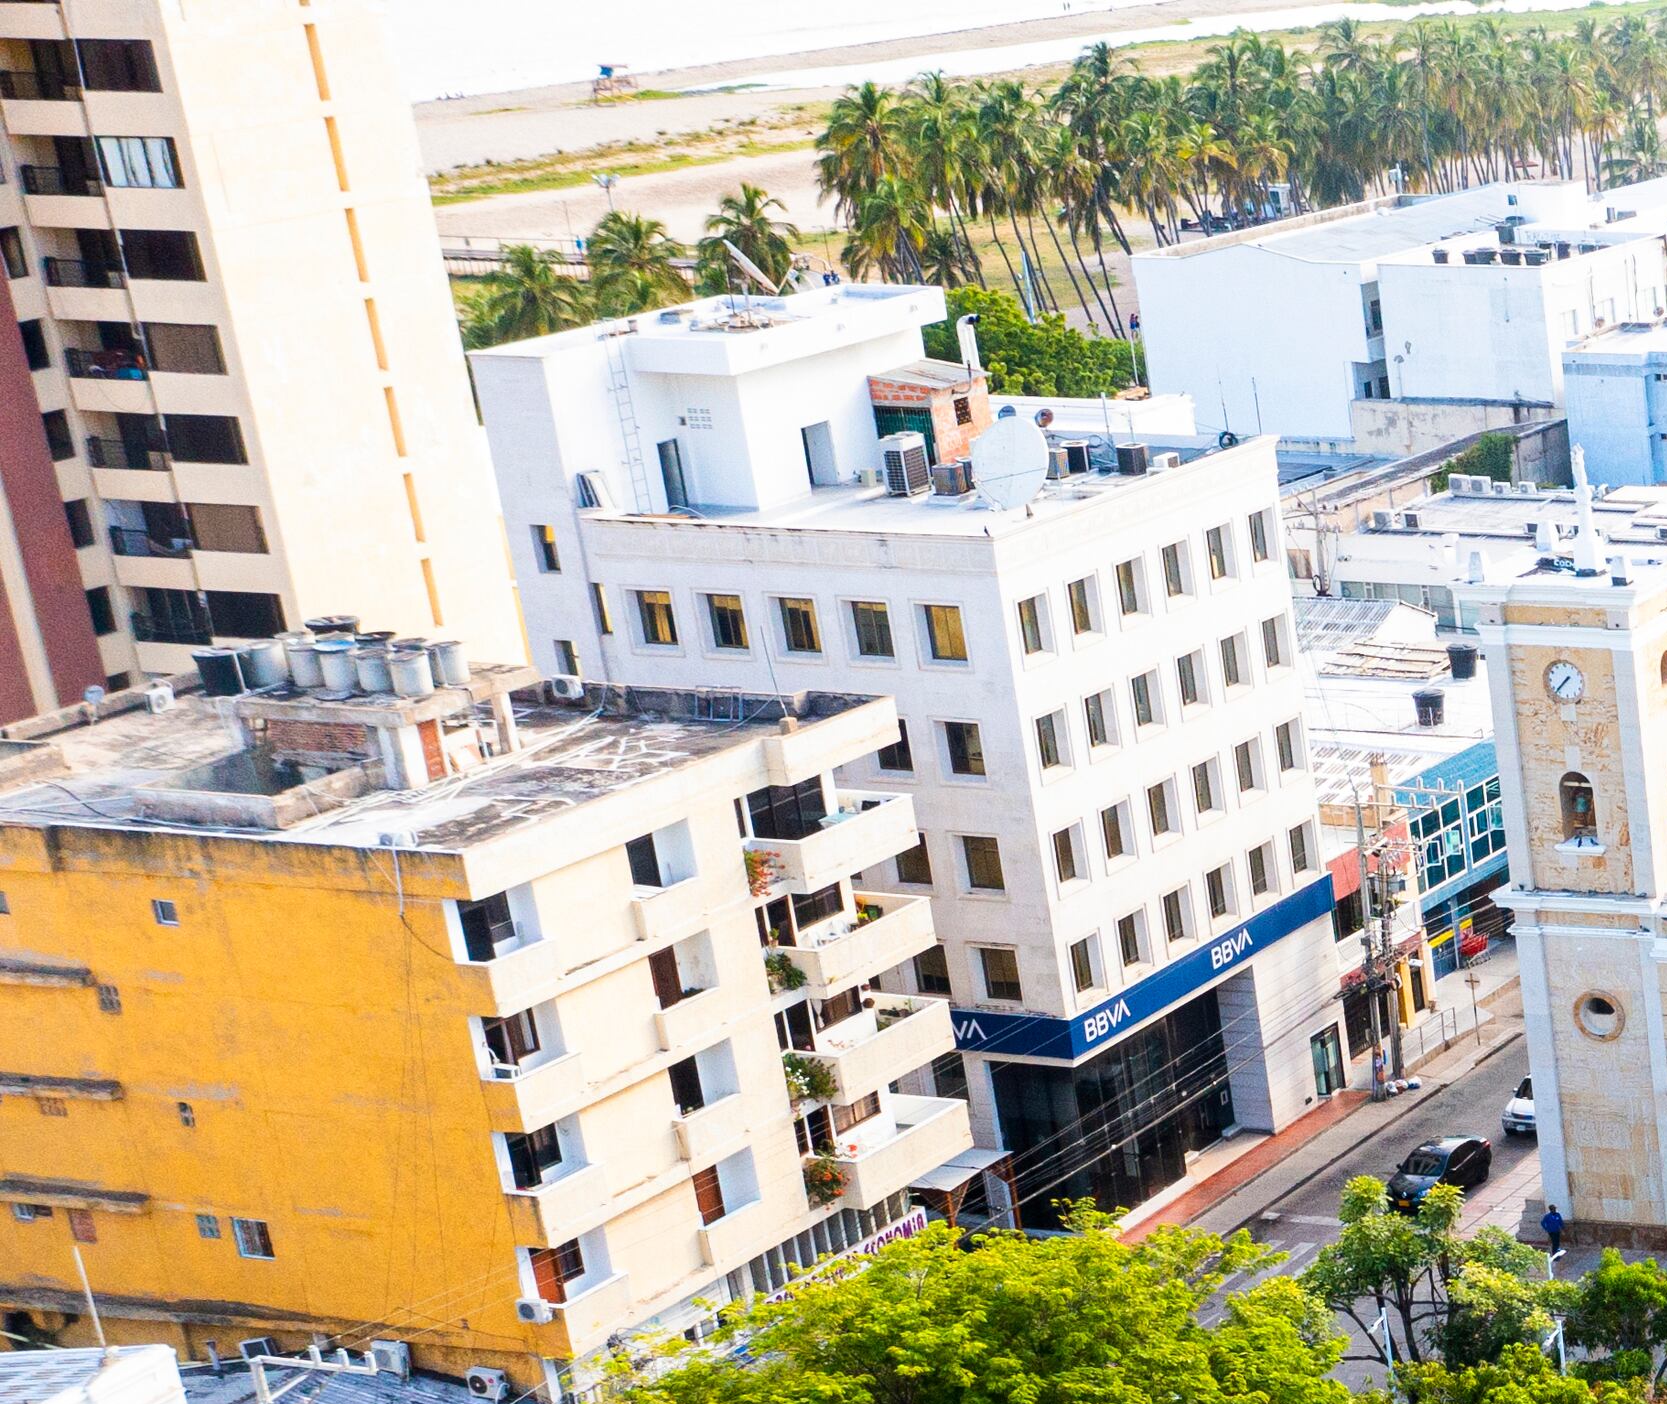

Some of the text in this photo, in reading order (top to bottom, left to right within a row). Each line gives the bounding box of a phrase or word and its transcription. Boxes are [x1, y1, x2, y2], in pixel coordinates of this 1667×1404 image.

[1210, 927, 1253, 969] BBVA
[953, 1019, 988, 1040] VA
[1084, 998, 1131, 1042] BBVA
